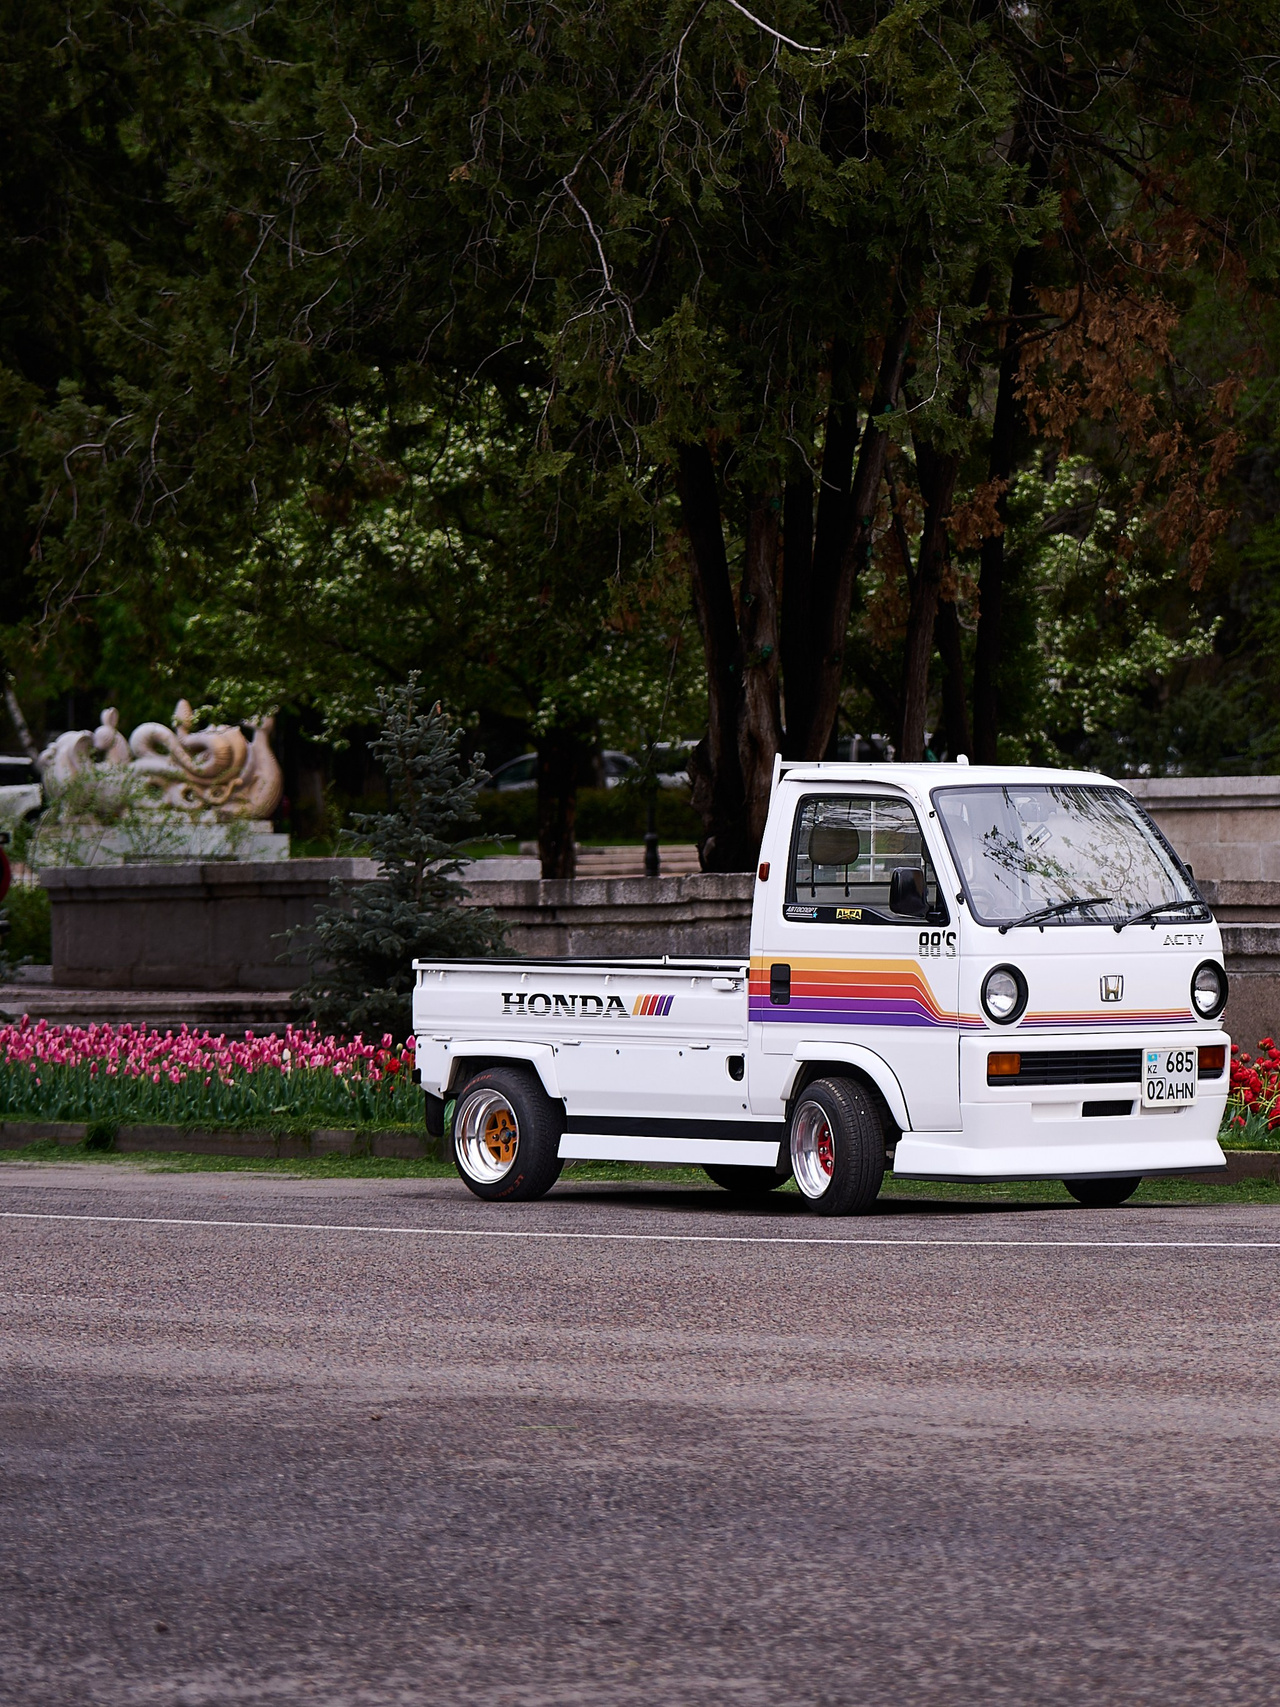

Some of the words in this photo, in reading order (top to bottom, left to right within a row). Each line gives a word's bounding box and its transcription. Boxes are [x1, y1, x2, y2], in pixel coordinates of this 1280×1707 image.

[1163, 934, 1204, 946] ACTY
[501, 992, 631, 1019] HONDA
[1147, 1064, 1158, 1074] KZ
[1166, 1051, 1194, 1073] 685
[1147, 1080, 1164, 1100] 02
[1167, 1082, 1194, 1100] AHN
